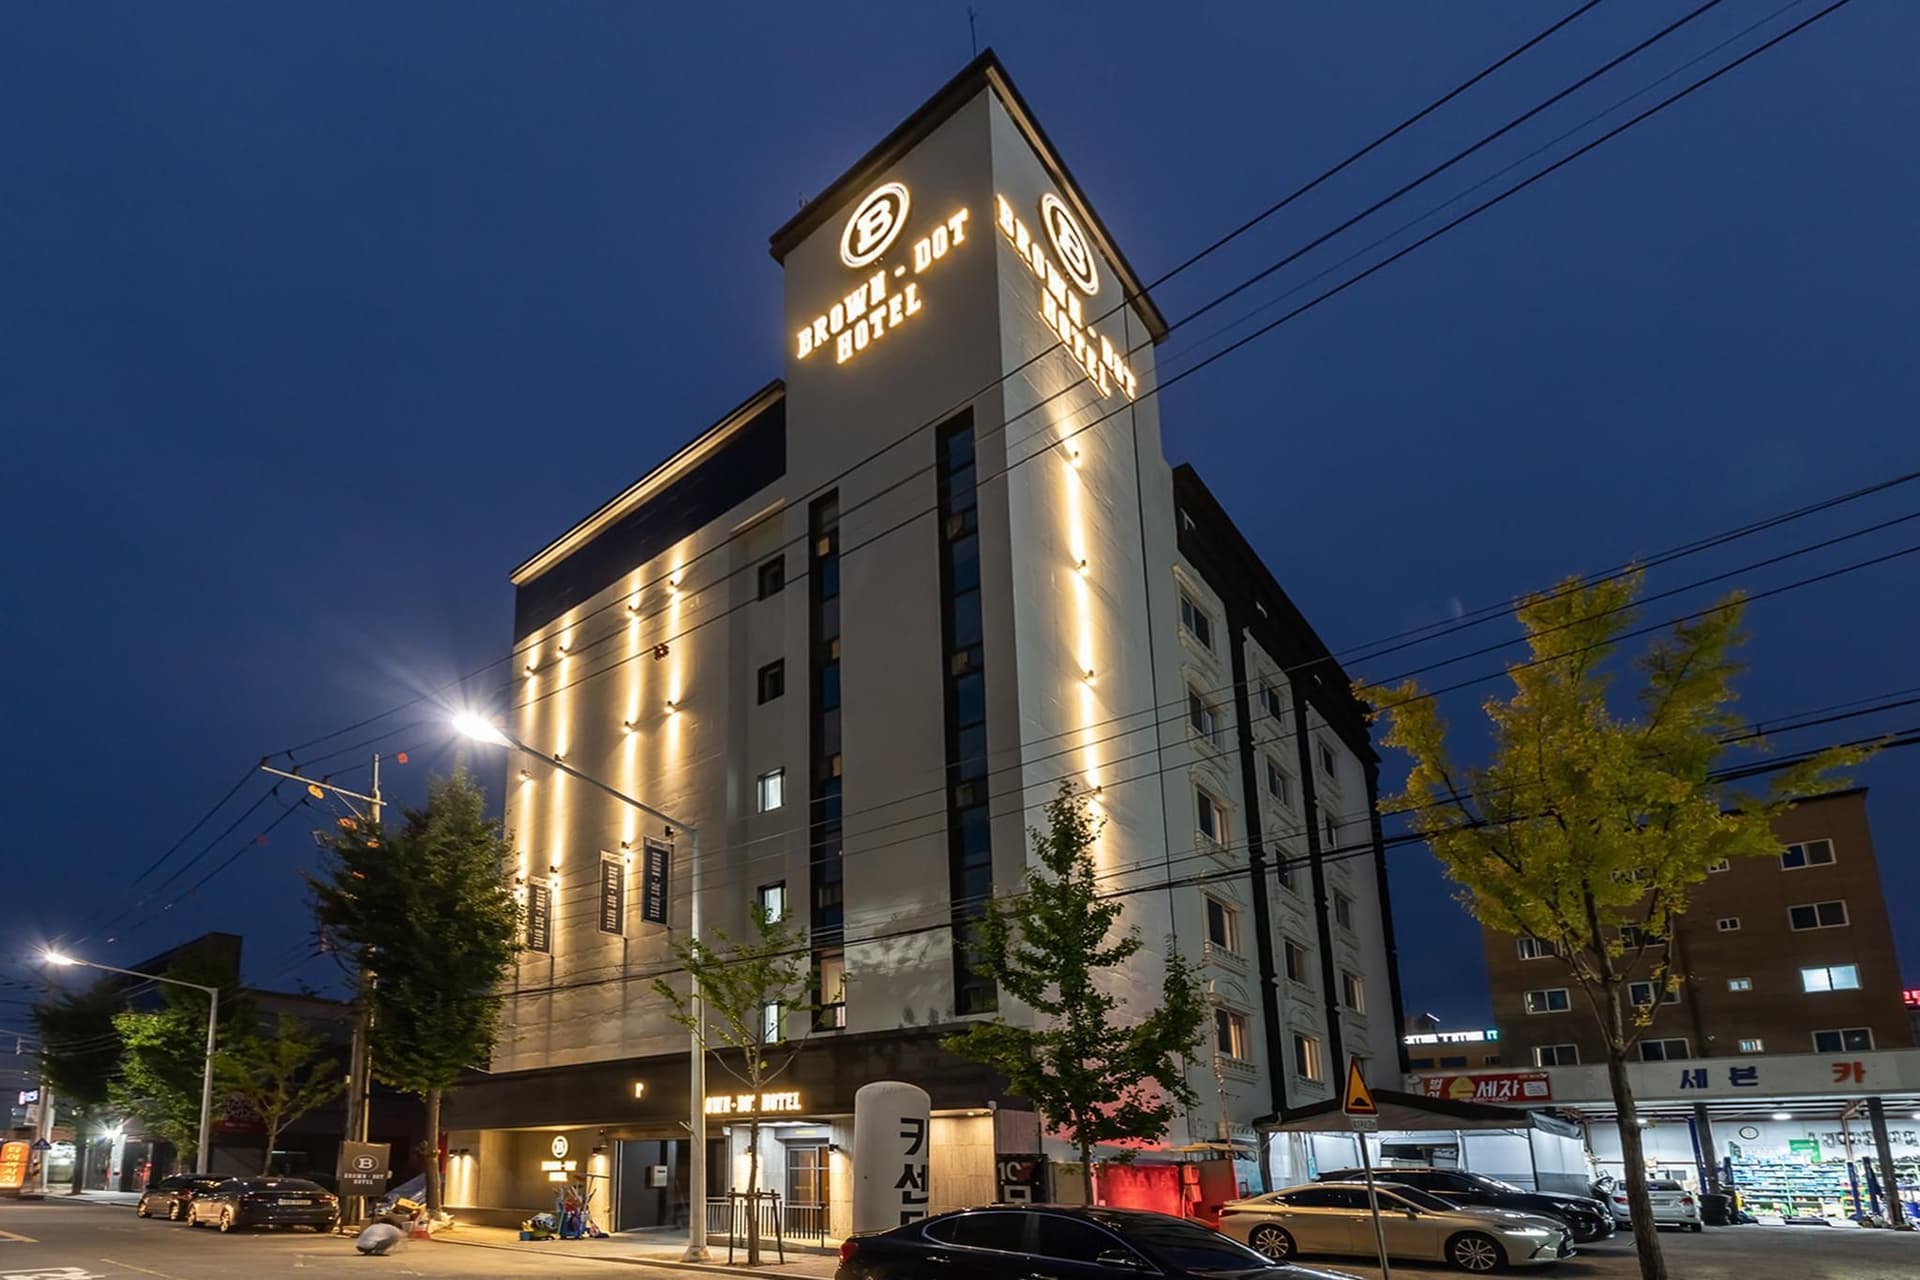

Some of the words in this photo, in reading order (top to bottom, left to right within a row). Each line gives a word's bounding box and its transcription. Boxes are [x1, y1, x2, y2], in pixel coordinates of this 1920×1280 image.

[796, 269, 887, 360] BROWN
[913, 207, 969, 275] DOT
[836, 282, 923, 365] HOTEL
[997, 193, 1083, 329] BROWN
[1101, 335, 1137, 401] DOT
[1041, 286, 1112, 399] HOTEL
[635, 1082, 644, 1099] P
[1476, 1079, 1521, 1097] 세차
[1679, 1066, 1759, 1089] 세븐
[1831, 1061, 1867, 1084] 카
